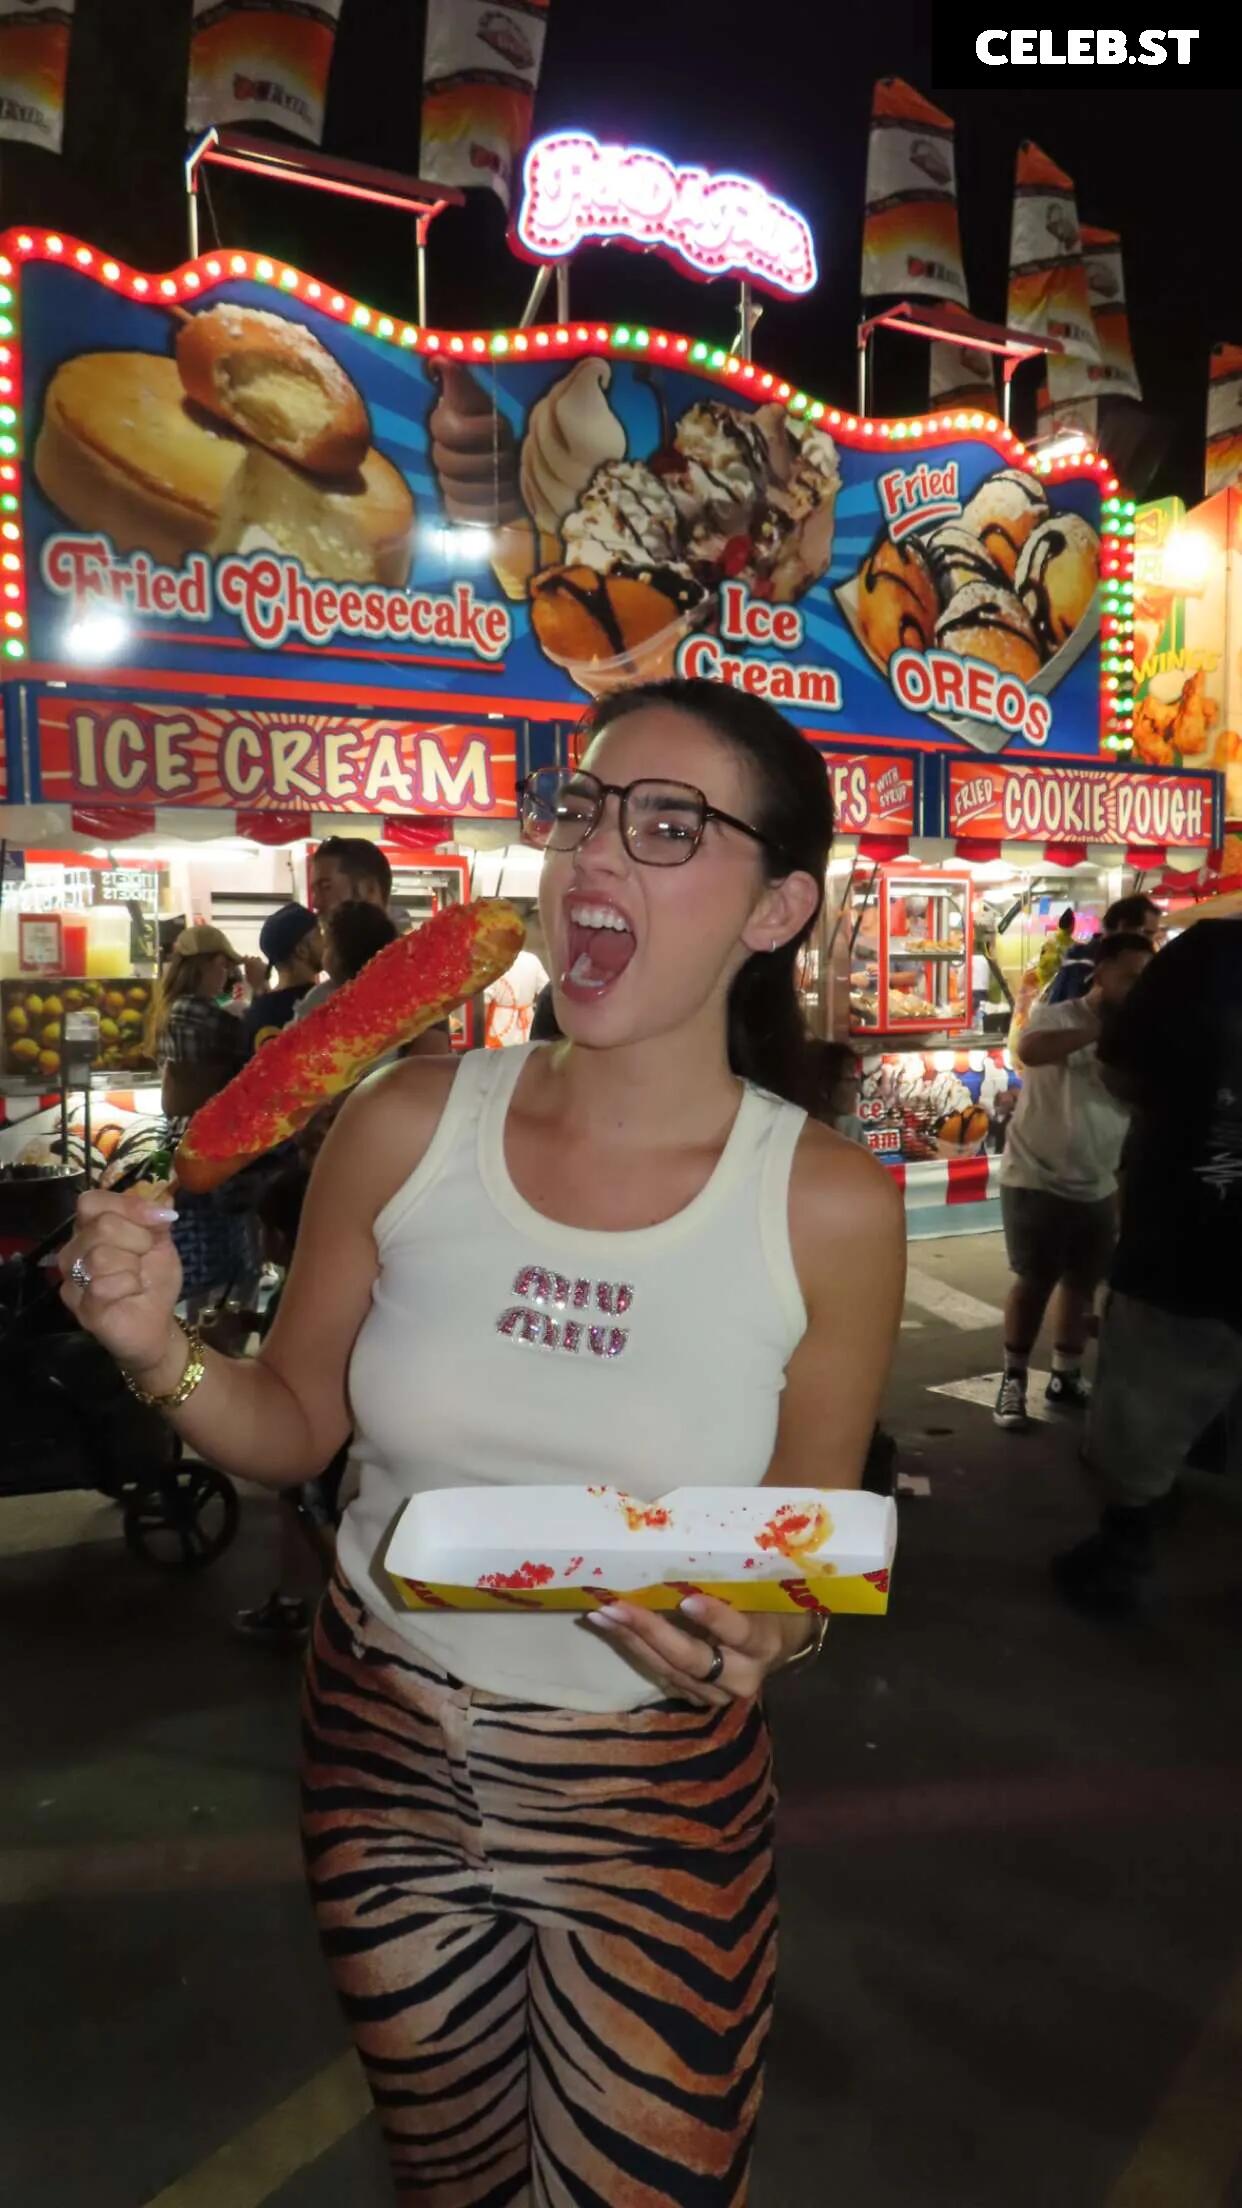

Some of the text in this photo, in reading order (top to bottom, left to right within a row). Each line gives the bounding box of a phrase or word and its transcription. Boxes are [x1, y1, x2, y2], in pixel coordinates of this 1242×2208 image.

[881, 463, 957, 516] Fried
[47, 540, 507, 653] Fried Cheesecake
[727, 587, 798, 643] Ice
[684, 639, 838, 704] Cream
[896, 657, 1049, 741] OREOS
[74, 715, 492, 806] ICE CREAM
[876, 766, 899, 792] WITH
[826, 766, 868, 823] FS
[879, 783, 907, 808] SYRUP
[954, 777, 1202, 837] FRIED COOKIE DOUGH
[858, 1101, 883, 1119] ce
